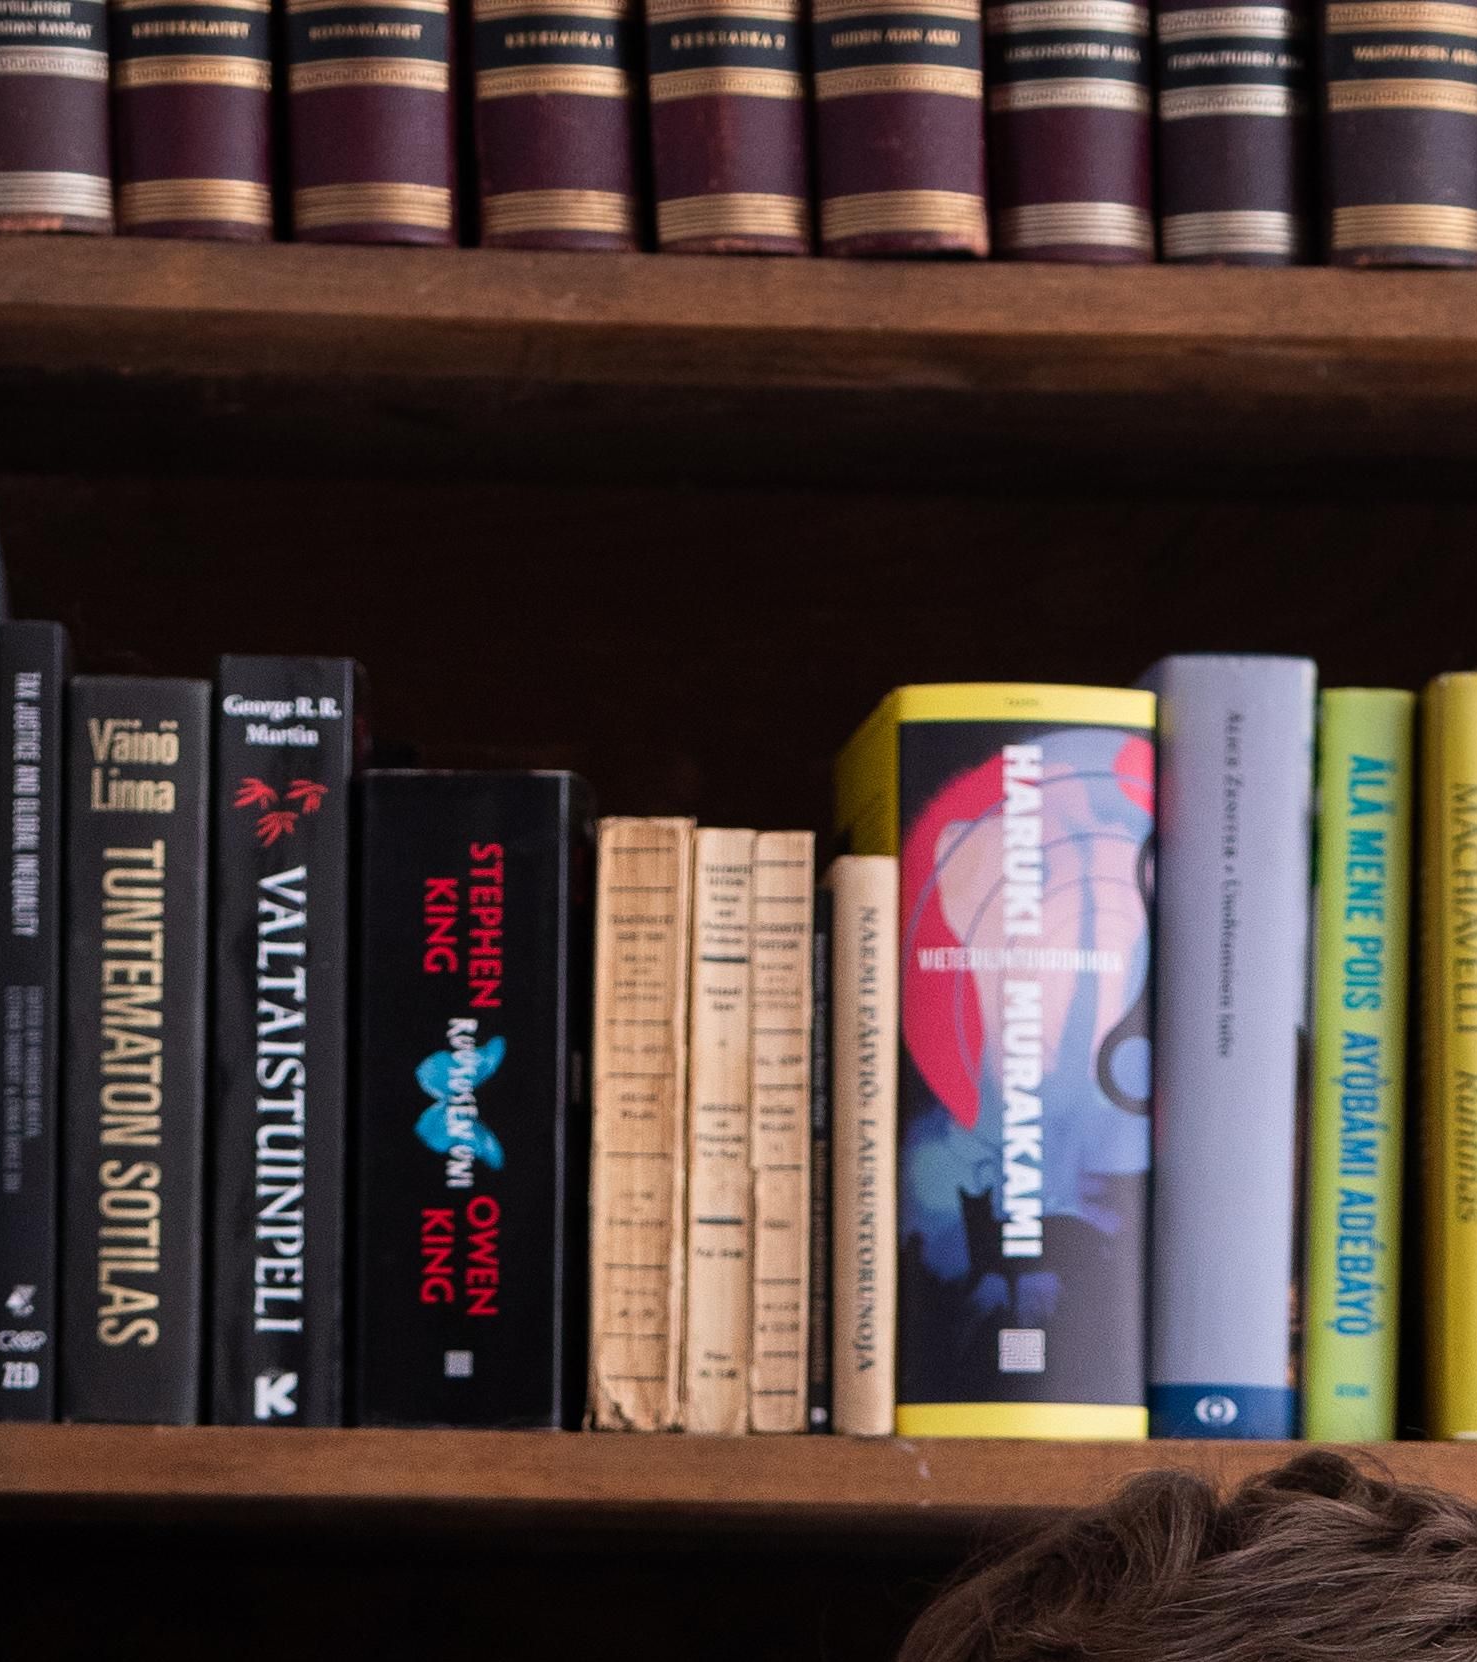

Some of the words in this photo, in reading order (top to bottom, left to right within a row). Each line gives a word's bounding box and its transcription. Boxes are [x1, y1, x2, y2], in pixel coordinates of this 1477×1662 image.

[88, 717, 181, 766] Väinö
[223, 693, 291, 720] George
[89, 774, 177, 814] Linna
[1346, 755, 1396, 820] ÄLÄ
[1001, 744, 1043, 936] HARUKI
[1345, 830, 1385, 922] MENE
[423, 877, 457, 975] KING
[469, 842, 505, 1009] STEPHEN
[1343, 931, 1384, 1012] POIS
[99, 839, 166, 1146] TUNTEMATON
[253, 866, 308, 1335] VALTAISTUINPELI
[1001, 981, 1044, 1258] MURAKAMI
[96, 1162, 161, 1348] SOTILAS
[421, 1208, 455, 1306] KING
[465, 1195, 501, 1317] OWEN
